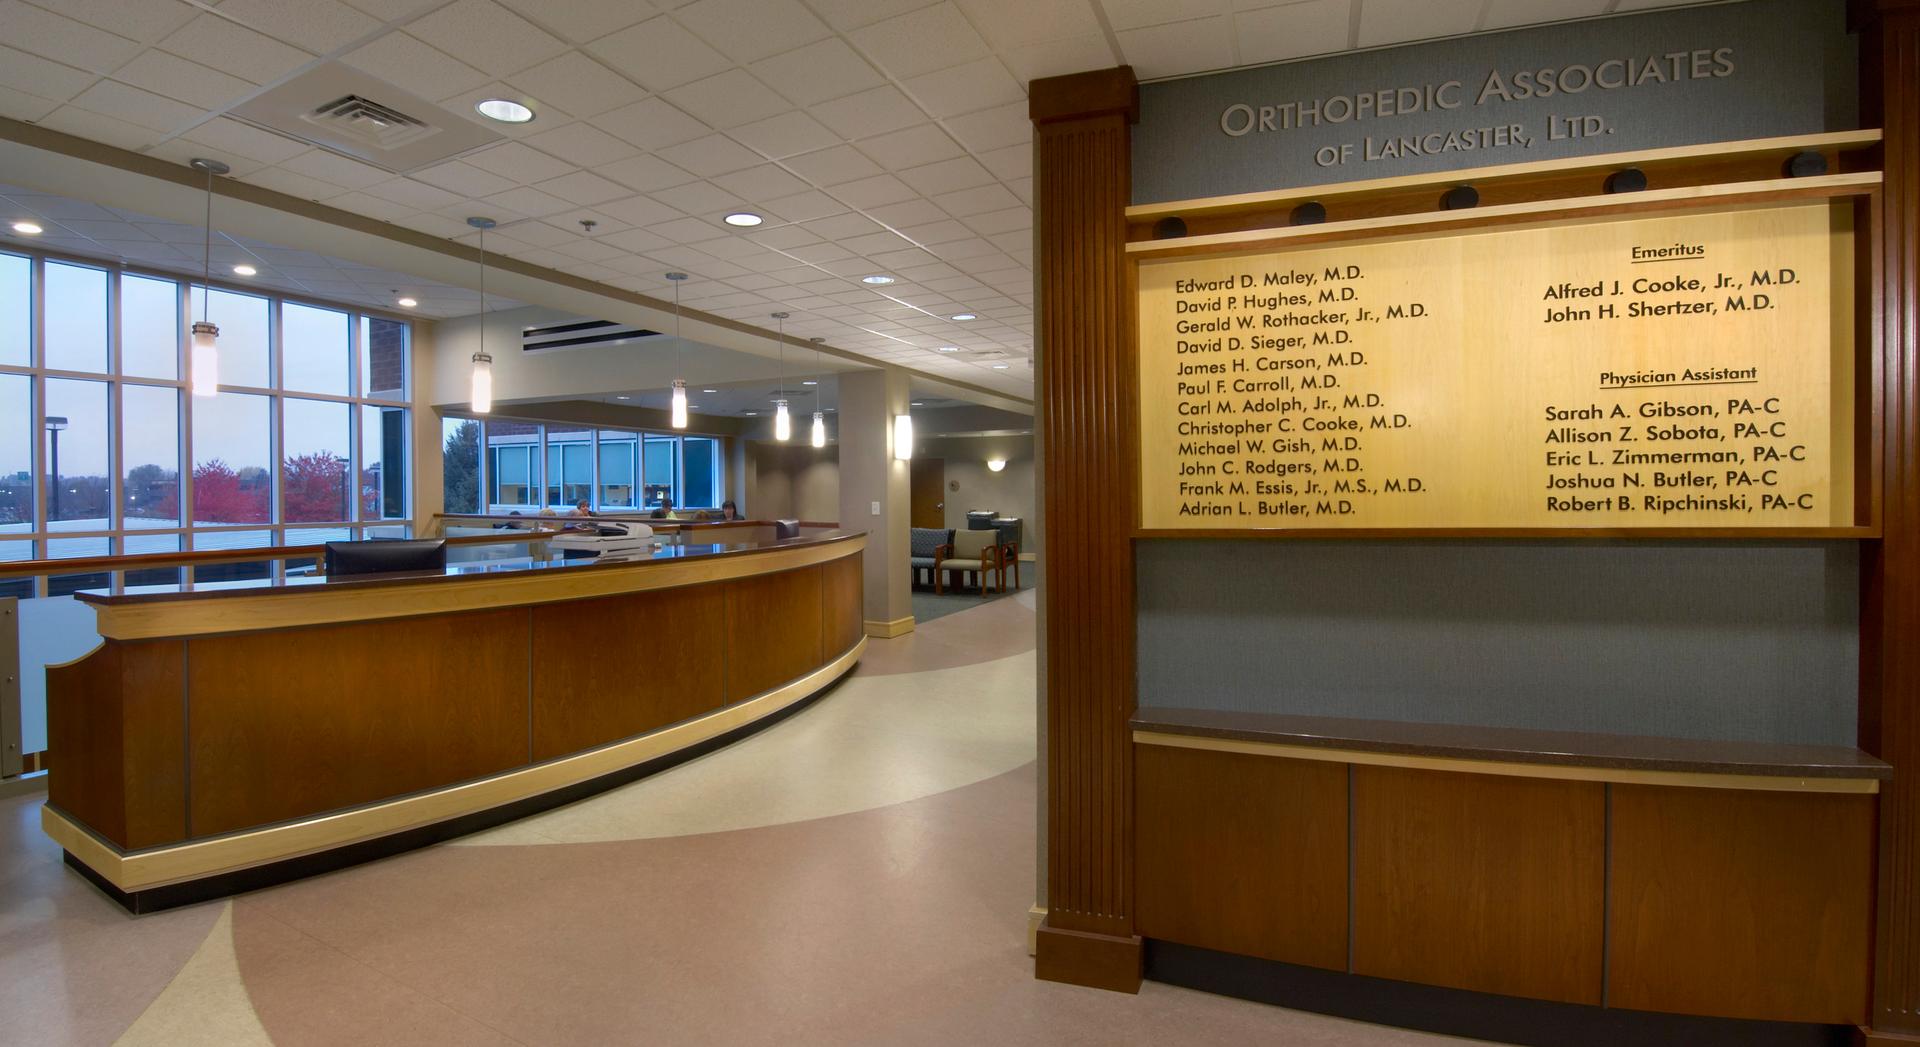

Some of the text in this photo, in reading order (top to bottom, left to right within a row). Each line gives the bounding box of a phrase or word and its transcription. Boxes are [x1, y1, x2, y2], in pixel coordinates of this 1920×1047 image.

[1220, 47, 1735, 138] ORTHOPEDIC ASSOCIATES
[1363, 123, 1532, 162] LANCASTER,
[1547, 114, 1614, 142] LTD.
[1632, 243, 1704, 259] Emeritus
[1176, 266, 1364, 293] Edward D. Maley, M.D.
[1544, 269, 1800, 300] Alfred J. Cooke, Jr., M.D.
[1177, 288, 1358, 313] David P. Hughes, M.D.
[1544, 295, 1774, 323] John H. Shertzer, M.D.
[1177, 304, 1428, 334] Gerald W. Rothacker, Jr., M.D.
[1177, 330, 1352, 354] David D. Sieger, M.D.
[1177, 352, 1367, 375] James H. Carson, M.D.
[1178, 375, 1340, 395] Paul F. Carroll, M.D.
[1601, 367, 1757, 384] Physician Assistant
[1178, 394, 1384, 415] Carl M. Adolph, Jr., M.D.
[1546, 398, 1779, 421] Sarah A. Gibson, PA-C
[1178, 415, 1411, 437] Christopher C. Cooke, M.D.
[1545, 422, 1785, 443] Allison Z. Sobota, PA-C
[1179, 437, 1361, 455] Michael W. Gish, M.D.
[1547, 446, 1805, 466] Eric L. Zimmerman, PA-C
[1179, 458, 1363, 477] John C. Rodgers, M.D.
[1180, 478, 1426, 496] Frank M. Essis, Jr., M.S., M.D.
[1546, 470, 1777, 489] Joshua N. Butler, PA-C
[1179, 501, 1355, 517] Adrian L. Butler, M.D.
[1548, 494, 1813, 514] Robert B. Ripchinski, PA-C
